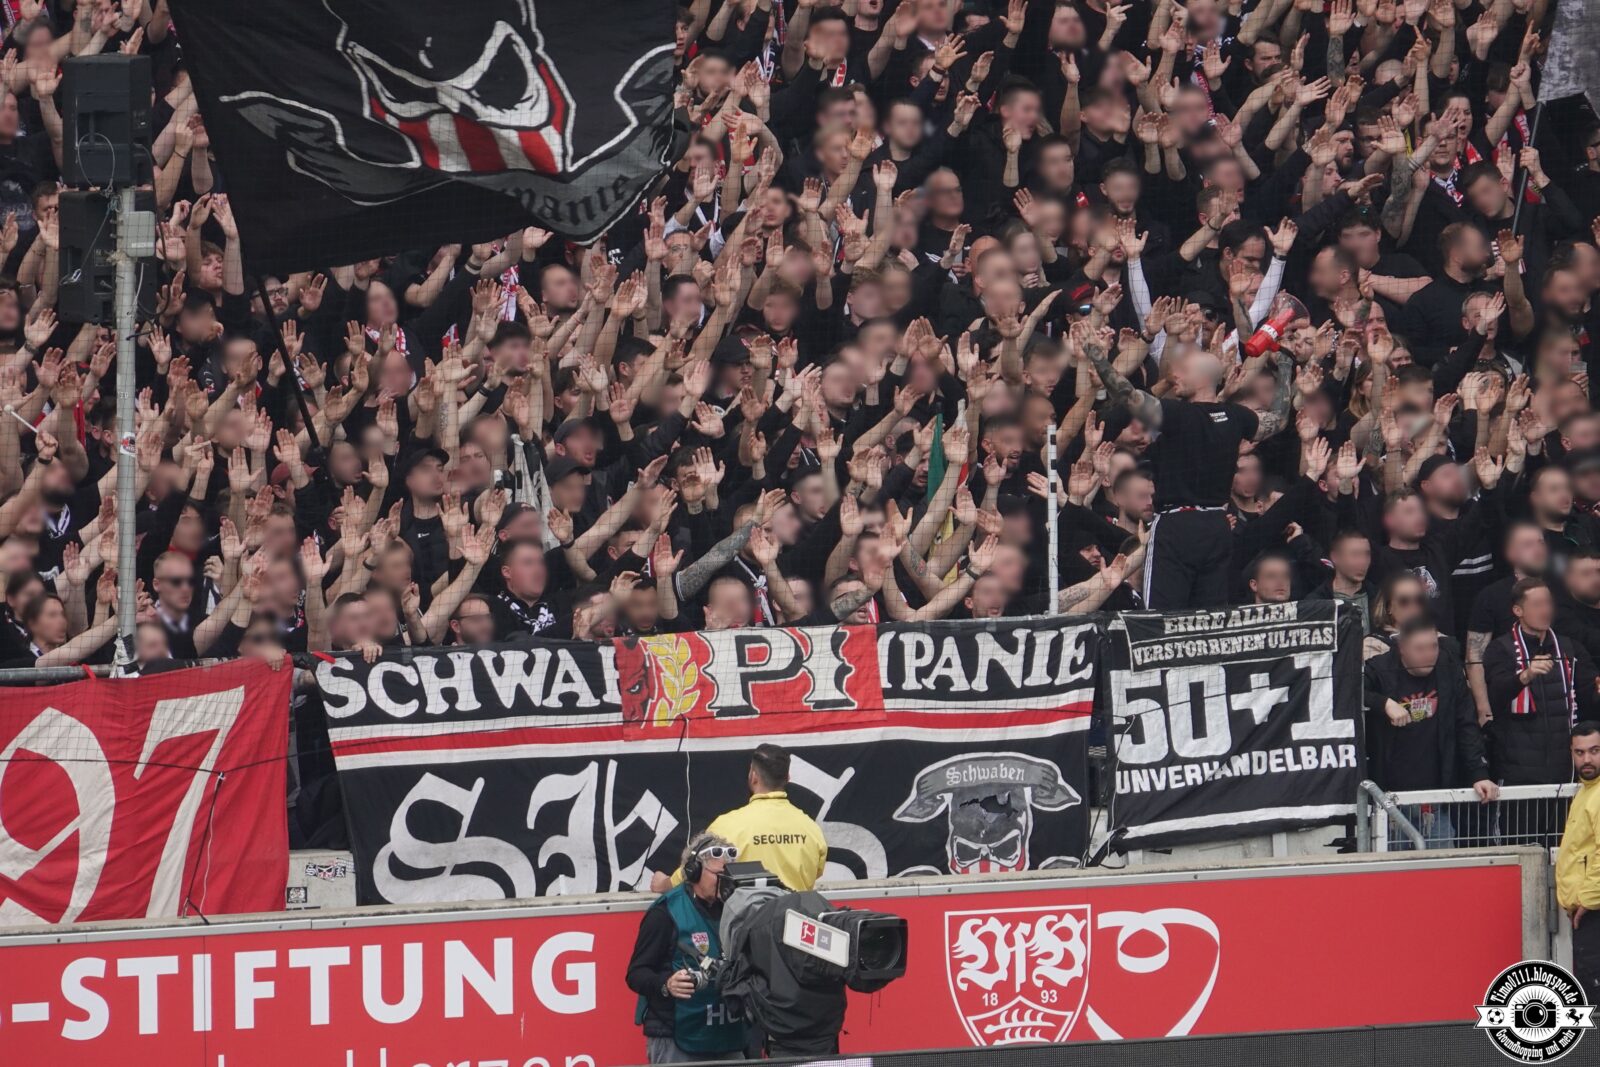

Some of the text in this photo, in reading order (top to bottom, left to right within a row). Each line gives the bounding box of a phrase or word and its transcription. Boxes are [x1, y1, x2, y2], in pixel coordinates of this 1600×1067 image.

[1164, 601, 1298, 634] EHRE ALLEN
[1132, 627, 1334, 666] VERSTORBENEN ULTRAS
[1110, 651, 1355, 764] 50+1
[946, 763, 1025, 786] Schwaben
[1116, 744, 1357, 794] UNVERHANDELBAR
[753, 834, 807, 846] SECURITY
[0, 931, 597, 1042] -STIFTUNG
[982, 989, 1058, 1007] 18 93
